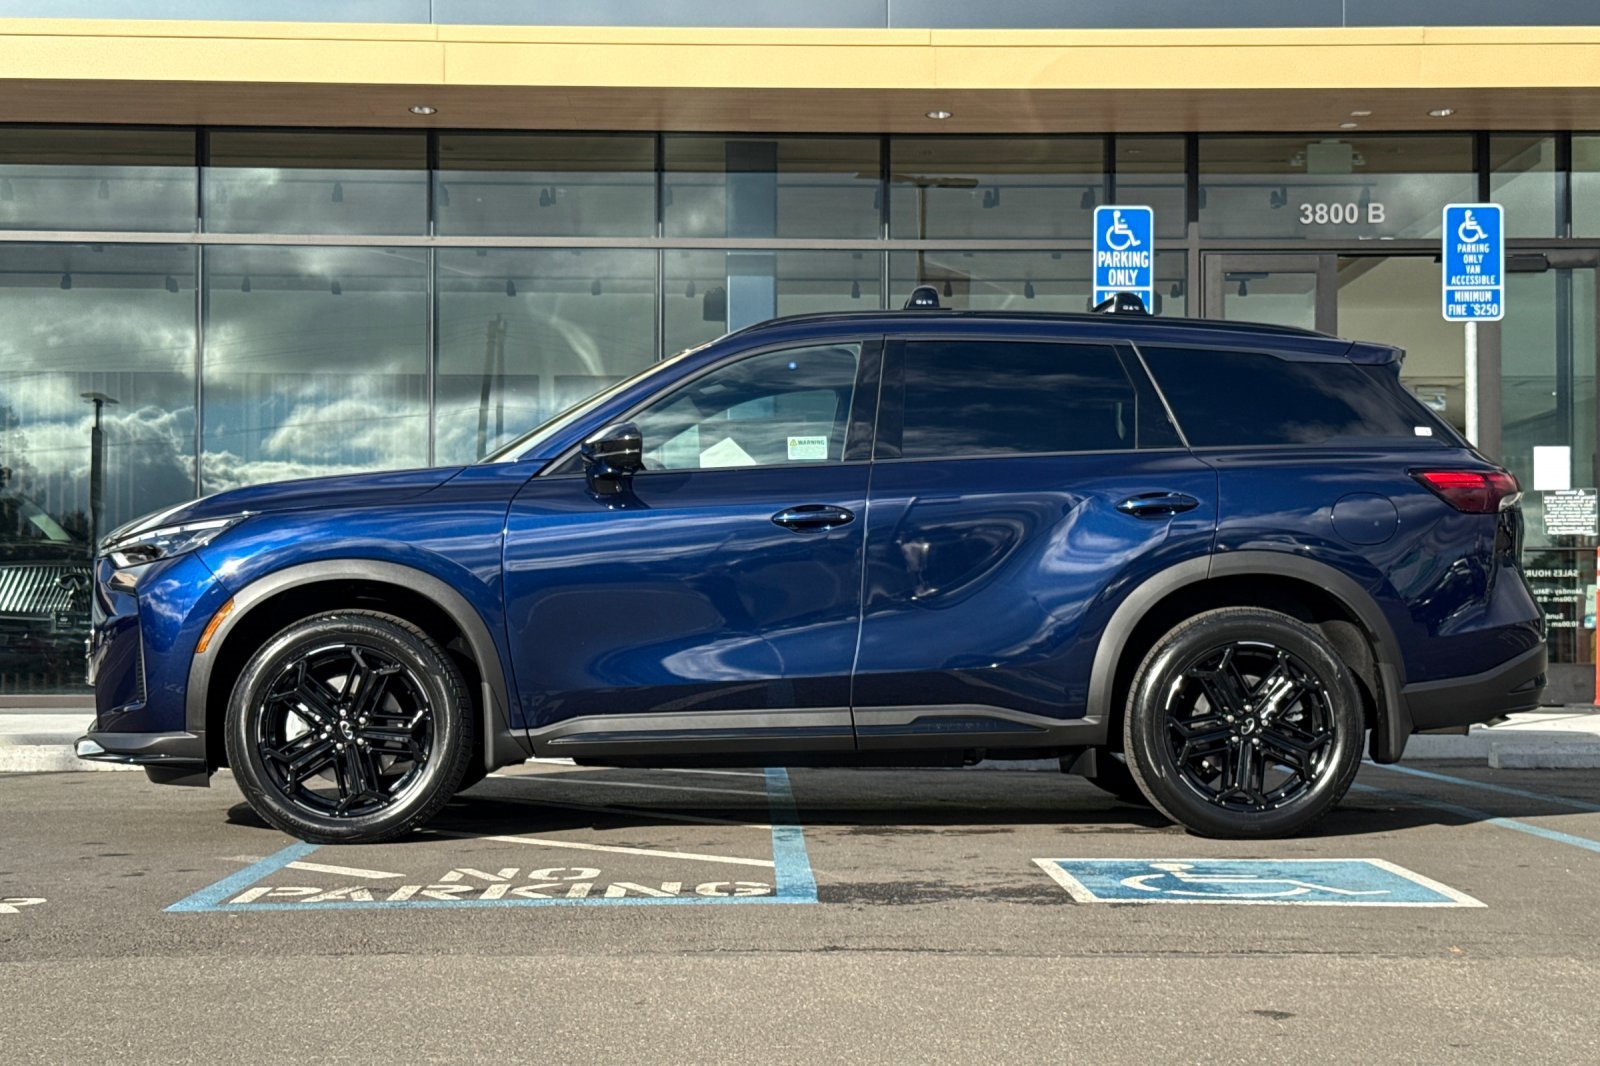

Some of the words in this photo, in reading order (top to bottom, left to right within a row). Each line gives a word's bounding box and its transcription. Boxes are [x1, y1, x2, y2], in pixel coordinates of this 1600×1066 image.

[1299, 203, 1359, 225] 3800
[1367, 203, 1385, 224] B
[1457, 243, 1490, 254] PARKING
[1098, 251, 1149, 268] PARKING
[1463, 254, 1484, 264] ONLY
[1465, 265, 1481, 274] VAN
[1108, 269, 1138, 286] ONLY
[1451, 275, 1496, 285] ACCESSIBLE
[1454, 291, 1492, 302] MINIMUM
[1448, 304, 1467, 316] FINE
[439, 867, 602, 882] NO
[228, 881, 771, 904] PARKING
